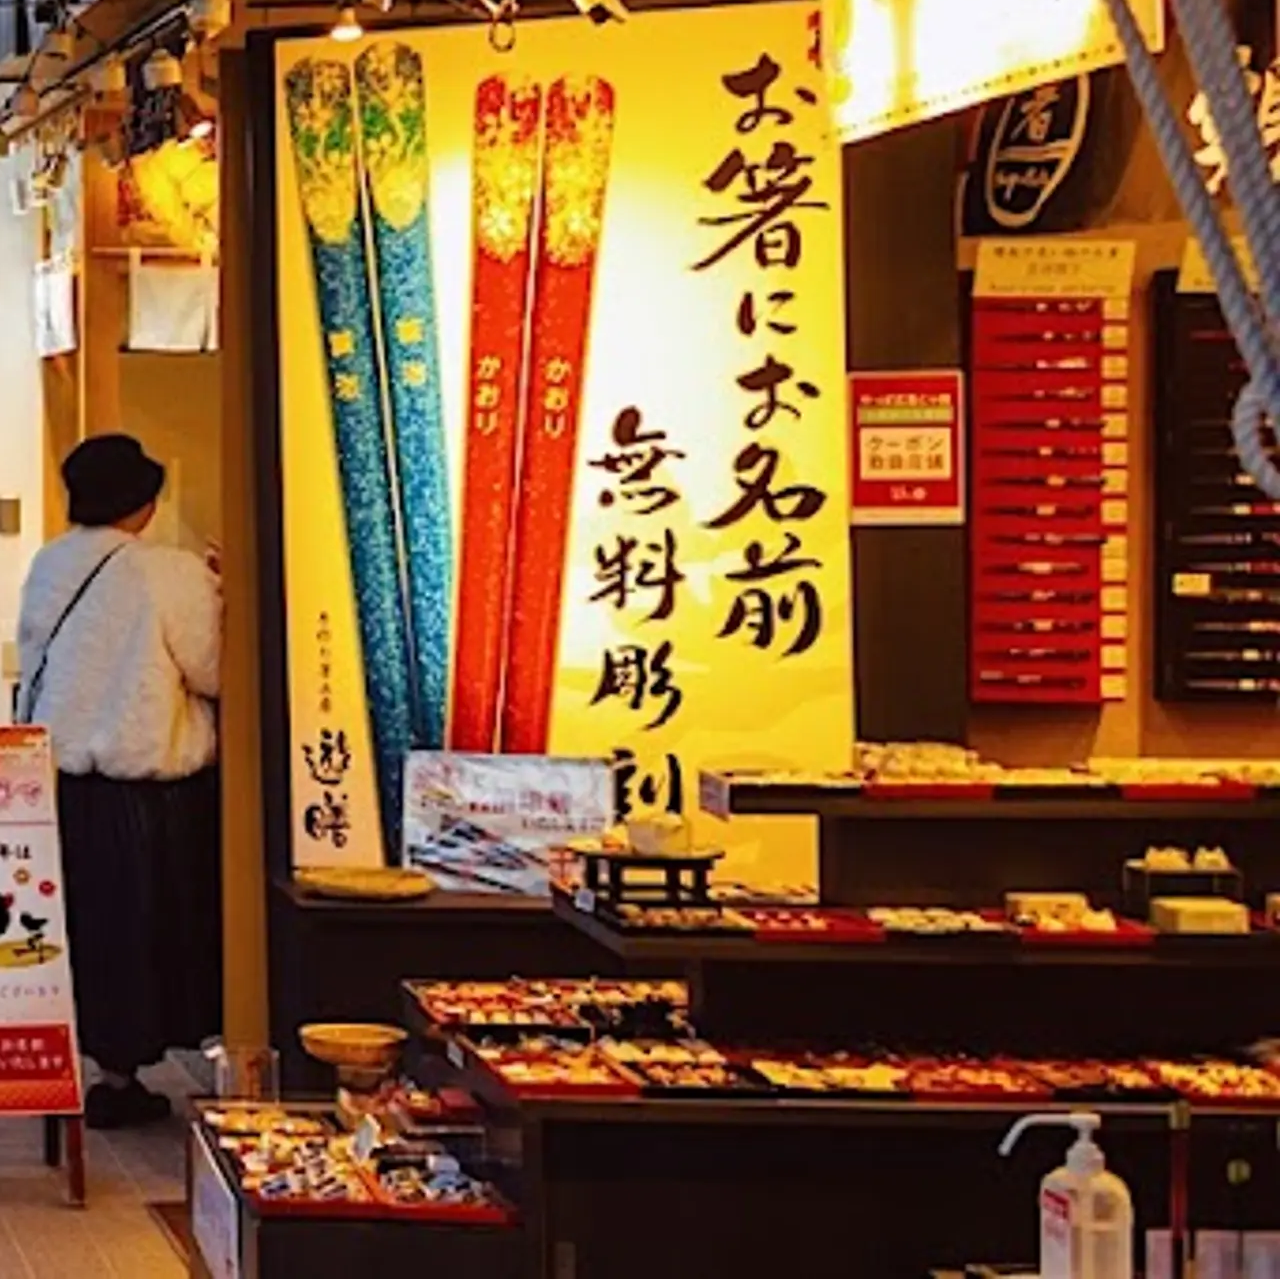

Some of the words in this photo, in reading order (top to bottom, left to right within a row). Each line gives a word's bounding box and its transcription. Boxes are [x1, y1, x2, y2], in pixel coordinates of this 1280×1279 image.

[476, 354, 501, 436] かおり
[543, 355, 572, 440] かおり
[691, 53, 830, 657] お箸にお名前
[587, 405, 687, 824] 無料彫刻
